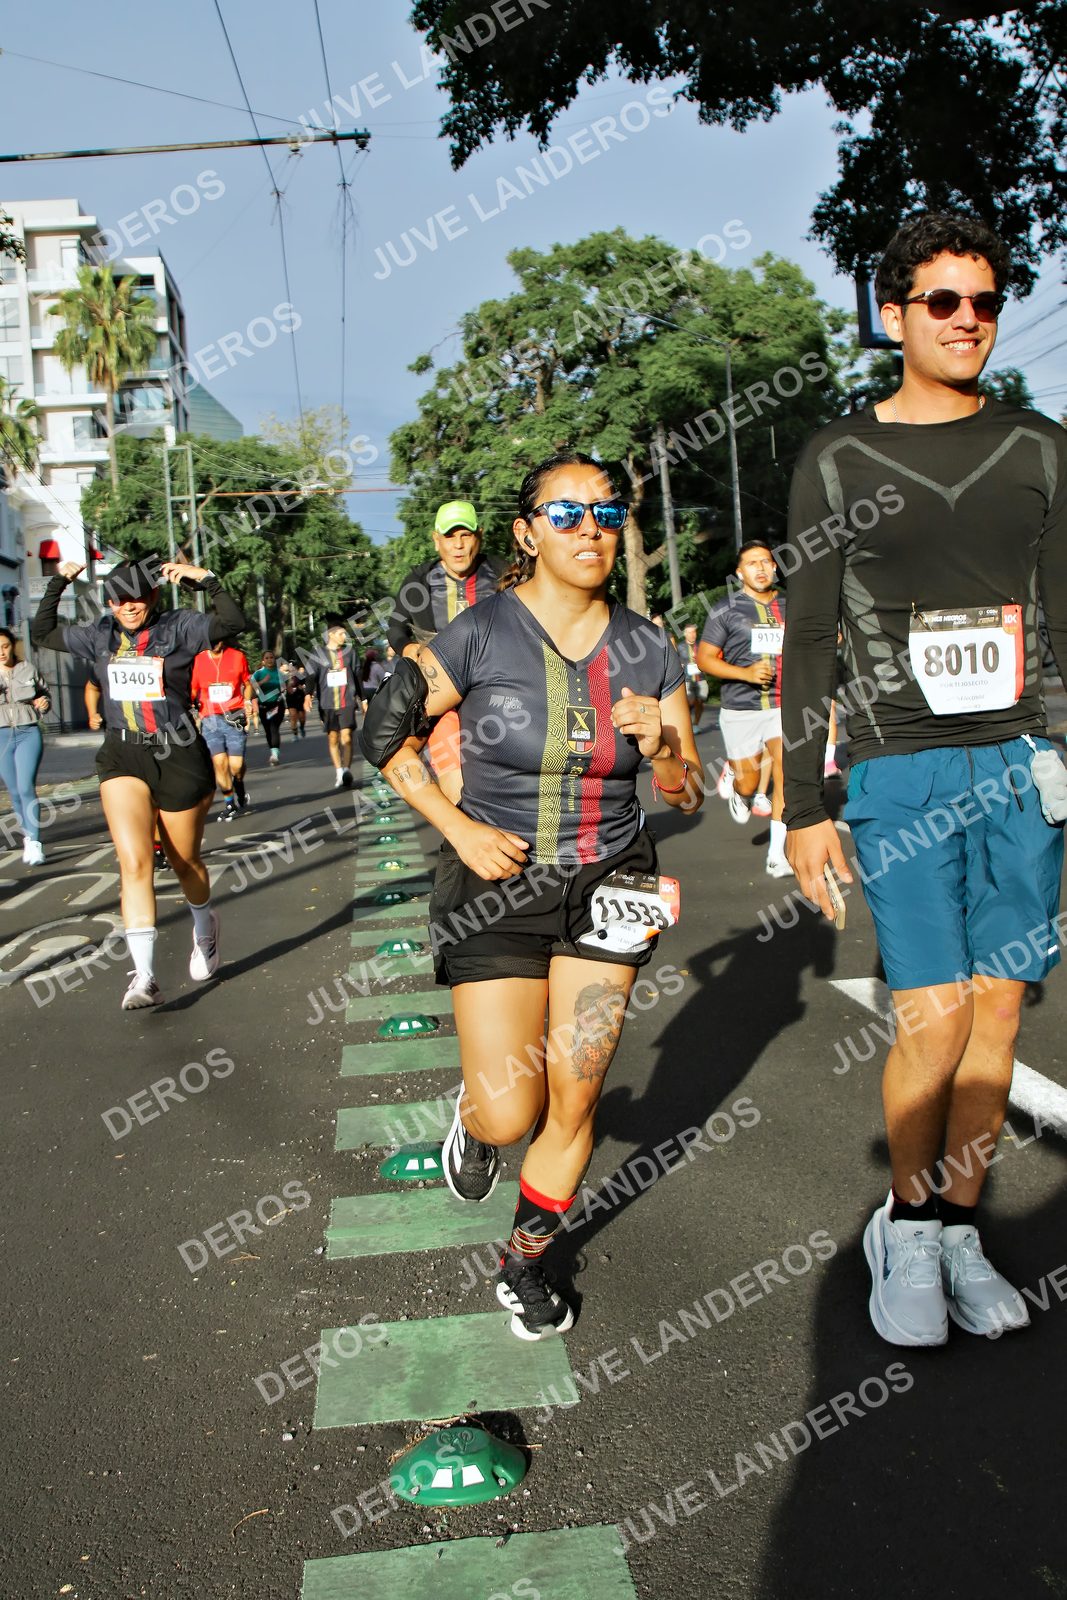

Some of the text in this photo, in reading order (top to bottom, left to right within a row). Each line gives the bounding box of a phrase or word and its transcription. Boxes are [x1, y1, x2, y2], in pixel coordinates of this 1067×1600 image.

[757, 632, 781, 642] 9175
[924, 641, 999, 677] 8010
[112, 671, 155, 685] 13405
[595, 896, 669, 930] 11533
